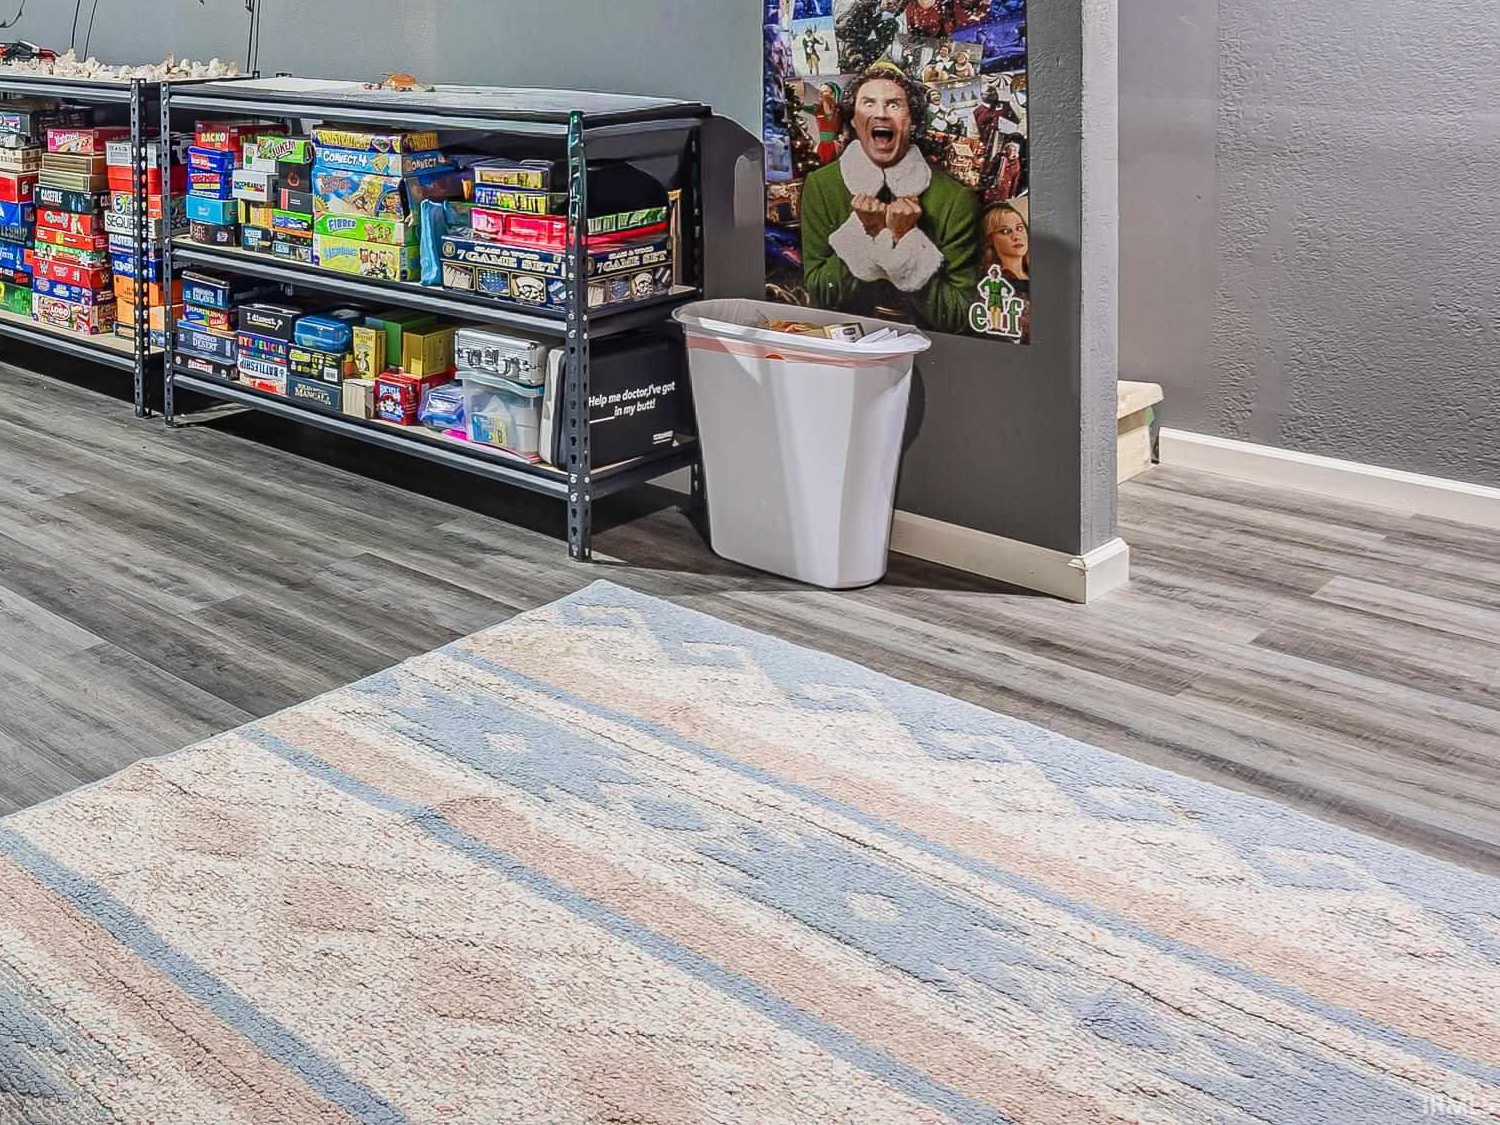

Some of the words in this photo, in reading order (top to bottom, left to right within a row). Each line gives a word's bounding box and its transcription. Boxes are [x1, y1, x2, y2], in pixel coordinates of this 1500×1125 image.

[323, 151, 357, 165] CONNECT
[358, 154, 368, 166] 4
[465, 252, 518, 267] GAME
[521, 259, 559, 273] SET
[603, 256, 640, 272] GAME
[642, 250, 667, 264] SET
[50, 304, 70, 316] LOGO
[192, 338, 219, 352] DESERT
[295, 386, 332, 406] MANCALA
[589, 394, 607, 407] Help
[608, 393, 621, 403] me
[662, 381, 675, 395] got
[614, 406, 622, 416] in
[623, 404, 635, 416] my
[636, 398, 656, 412] butt!
